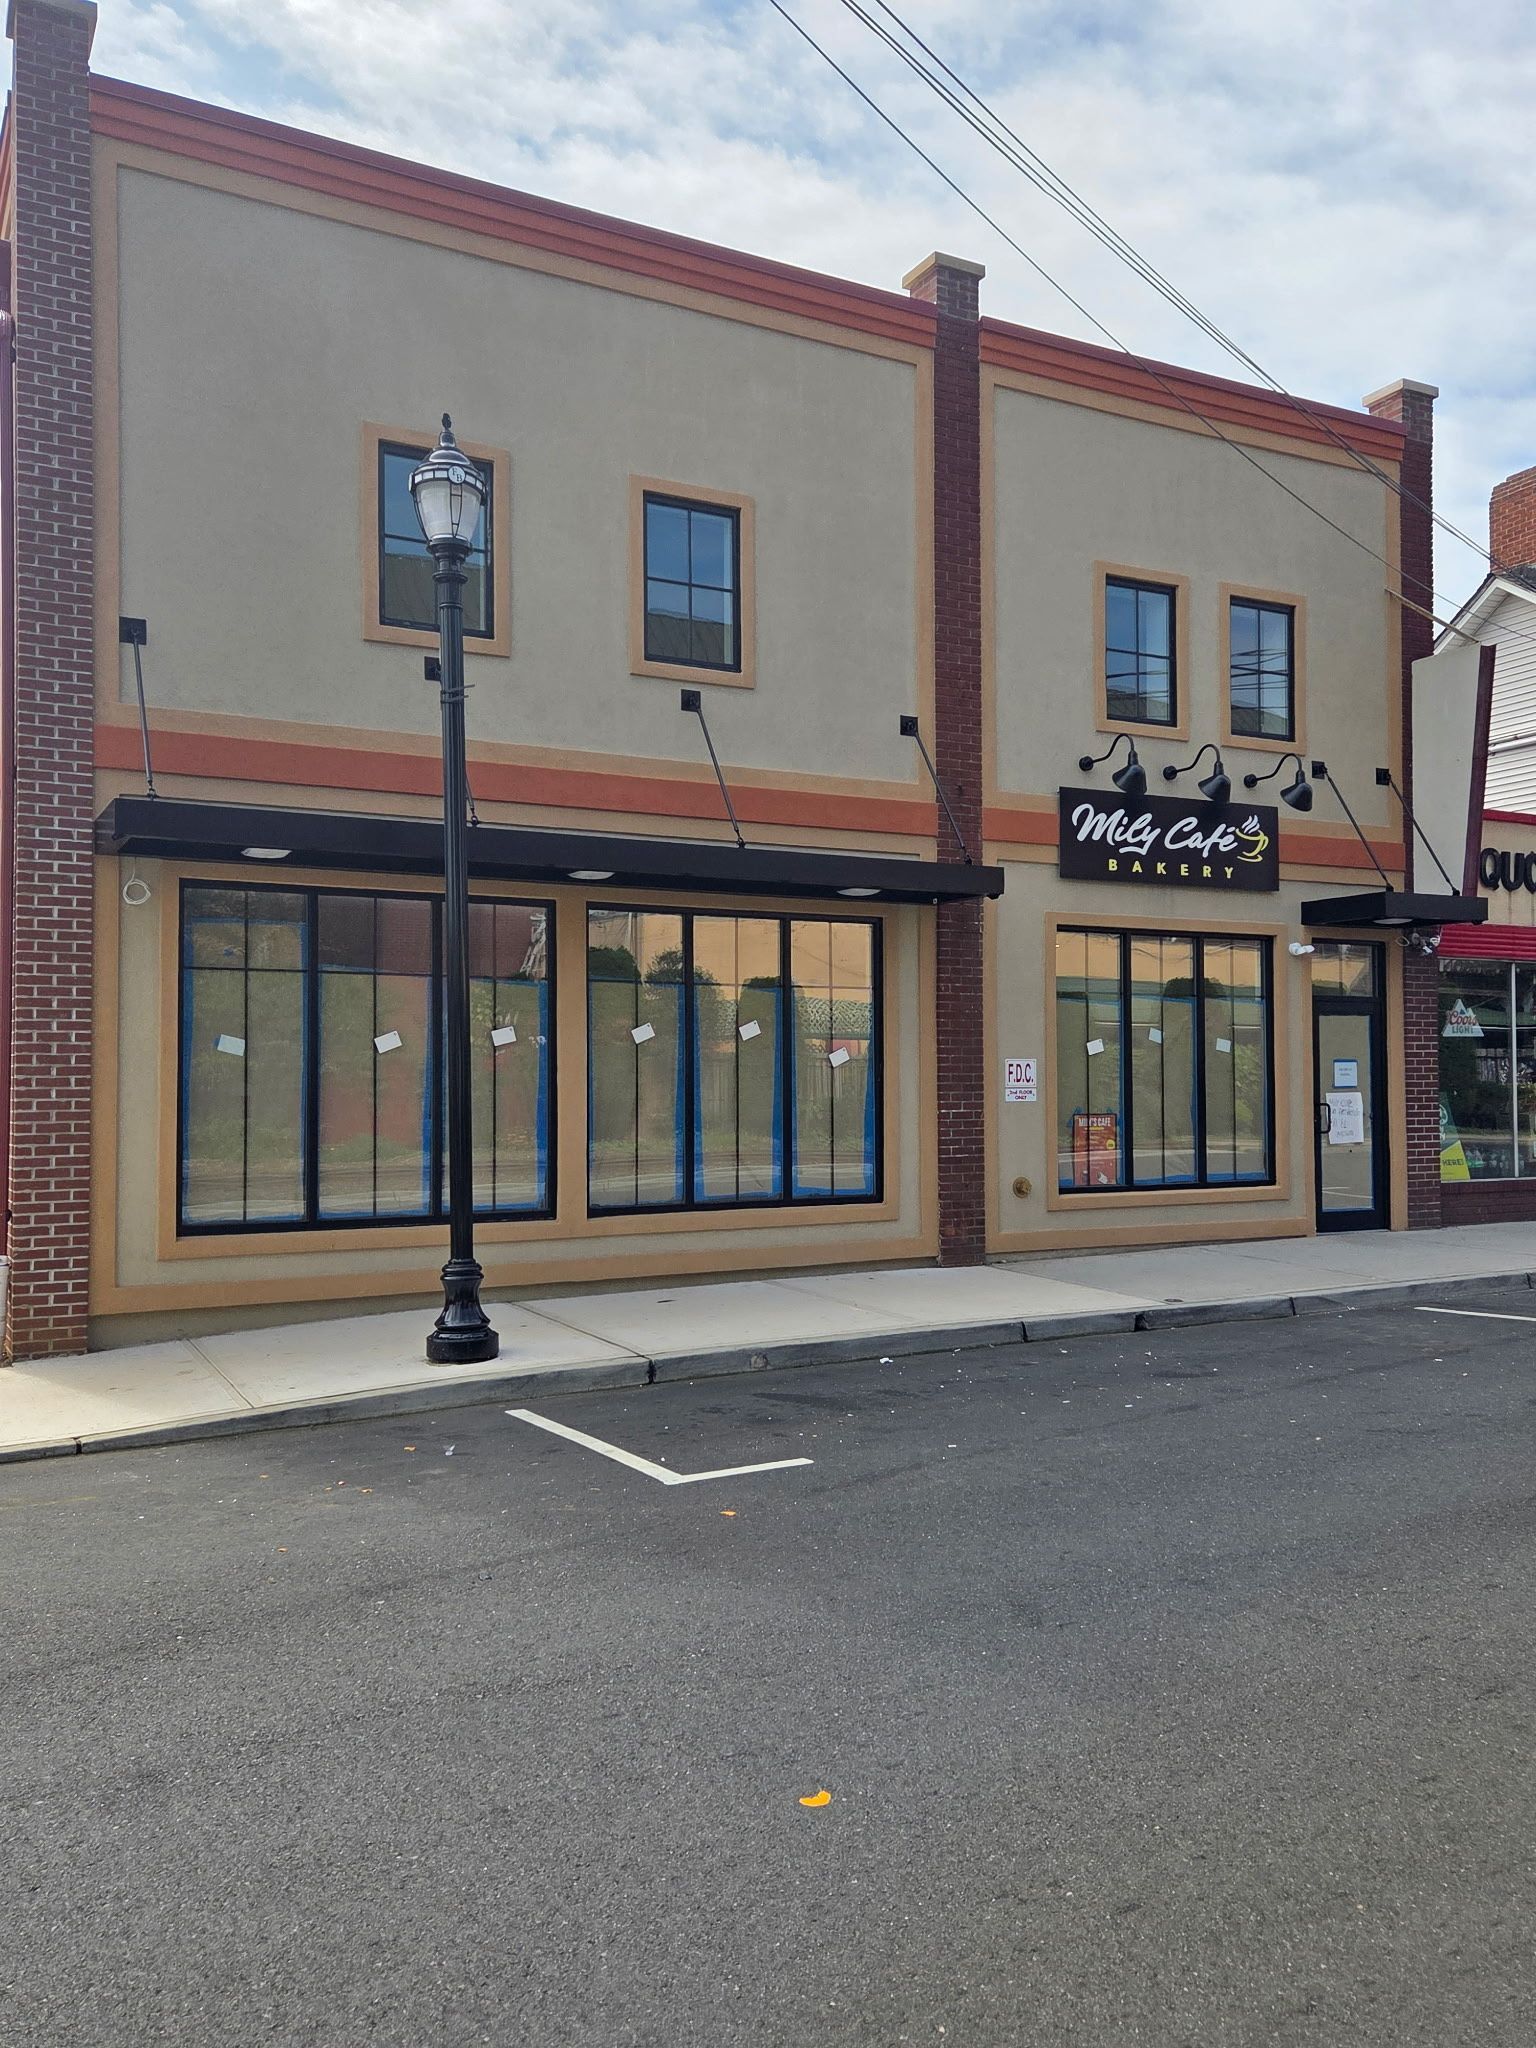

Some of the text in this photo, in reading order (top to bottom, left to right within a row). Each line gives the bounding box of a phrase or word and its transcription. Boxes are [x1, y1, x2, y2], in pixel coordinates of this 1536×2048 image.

[1071, 803, 1238, 858] Mily Café
[1108, 858, 1234, 879] BAKERY
[1008, 1063, 1034, 1083] F.D.C.
